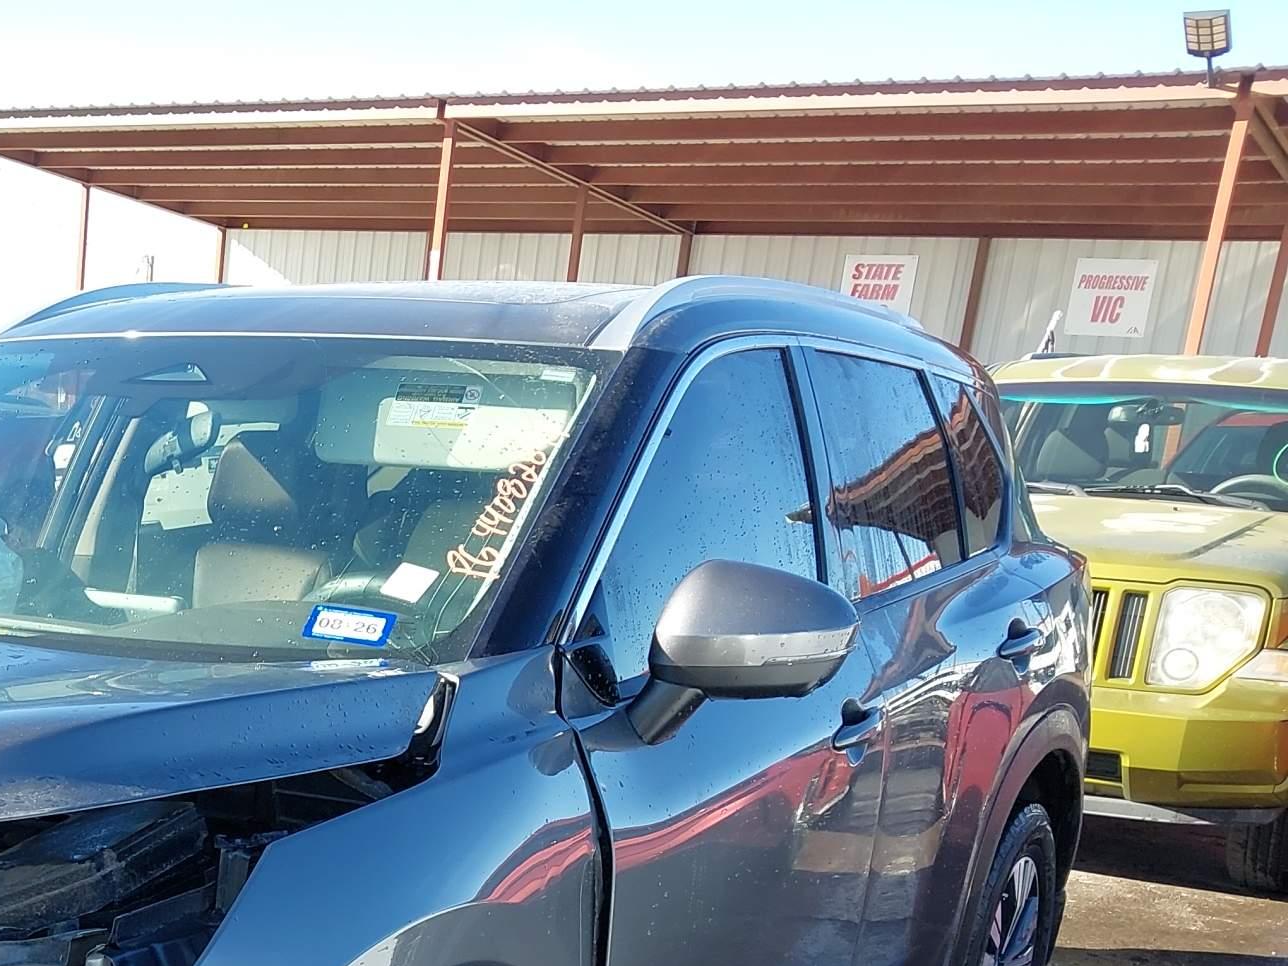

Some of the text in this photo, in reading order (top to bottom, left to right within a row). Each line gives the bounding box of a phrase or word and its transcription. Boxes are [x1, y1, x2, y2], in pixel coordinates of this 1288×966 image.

[852, 263, 905, 280] STATE
[1078, 274, 1149, 291] PROGRESSIVE
[850, 284, 899, 300] FARM
[1090, 296, 1125, 323] VIC
[353, 621, 378, 634] 26
